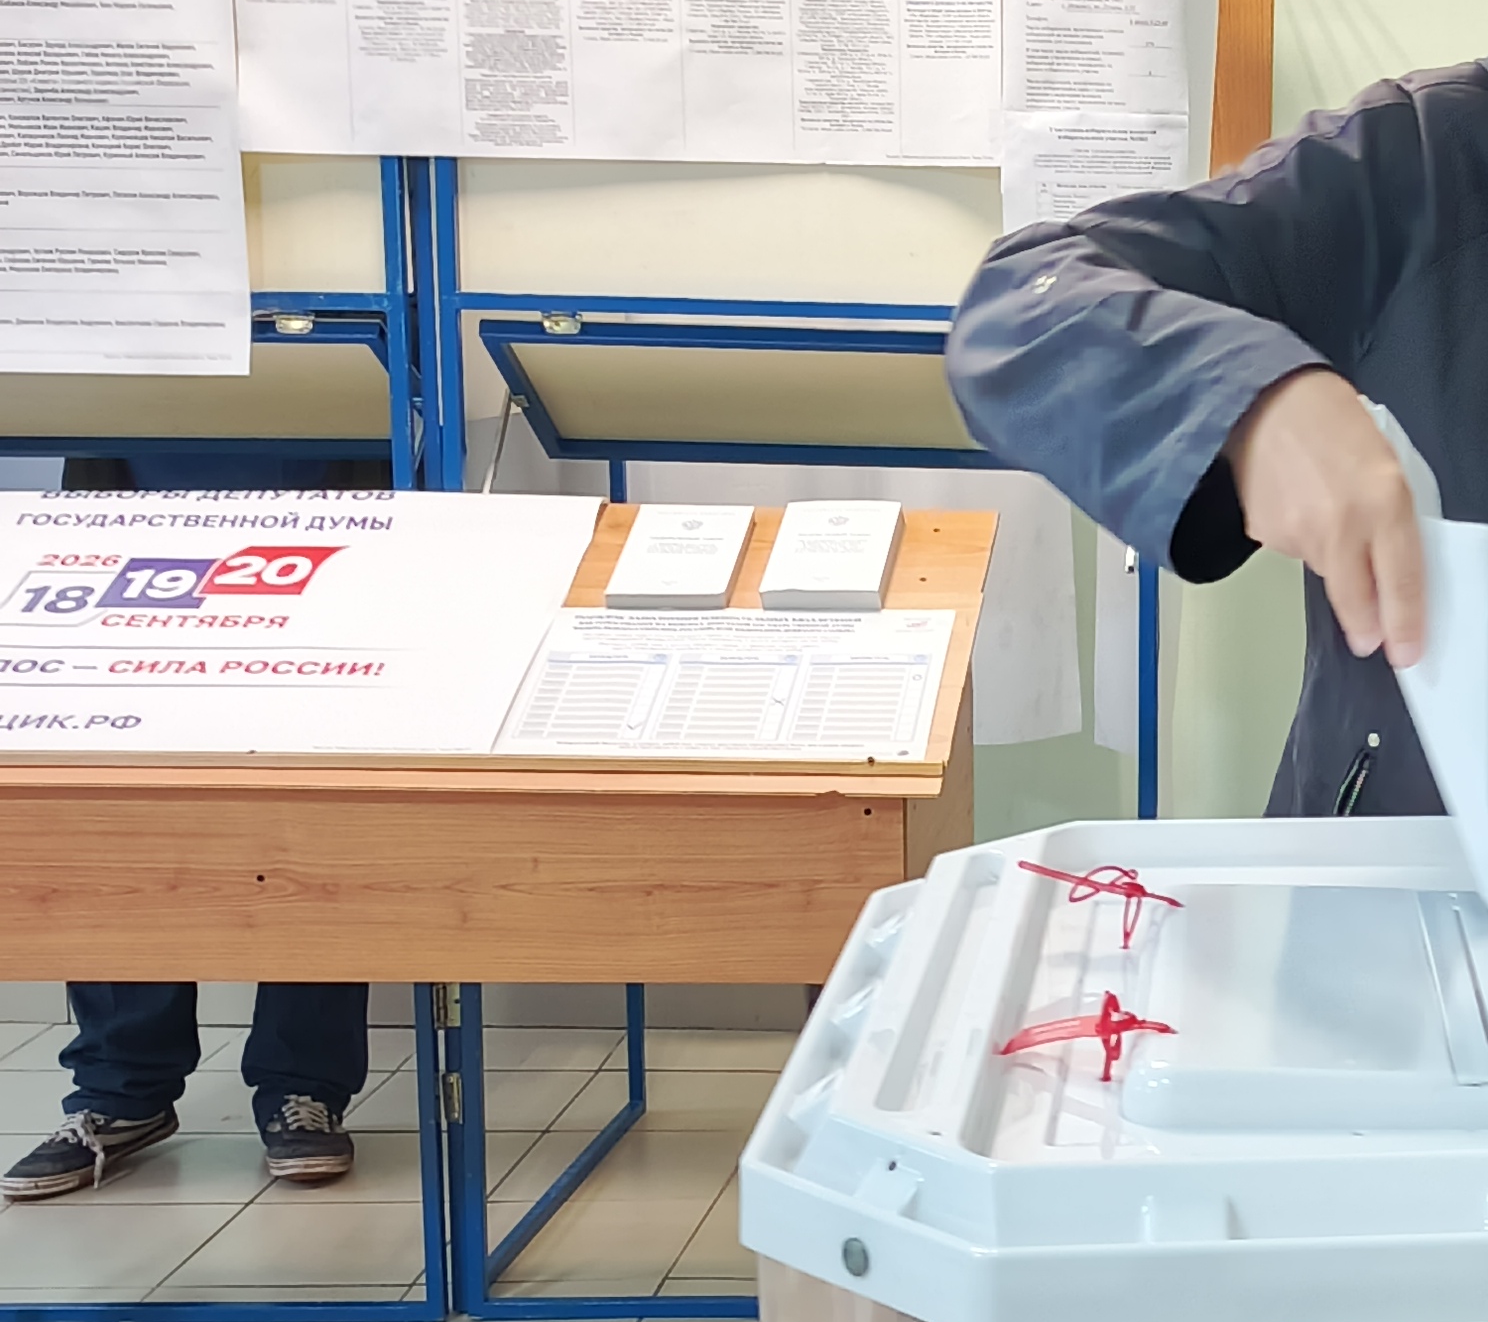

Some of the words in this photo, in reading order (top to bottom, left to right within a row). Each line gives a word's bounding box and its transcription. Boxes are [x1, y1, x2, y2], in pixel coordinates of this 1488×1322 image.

[16, 511, 300, 530] ГОСУДАРСТВЕННОЙ
[305, 515, 393, 531] ДУМЫ
[36, 554, 122, 567] 2026
[20, 584, 96, 614] 18
[121, 569, 198, 599] 19
[212, 555, 313, 586] 20
[100, 613, 290, 629] СЕНТЯБРЯ
[107, 659, 207, 675] СИЛА
[218, 661, 385, 676] РОССИИ!
